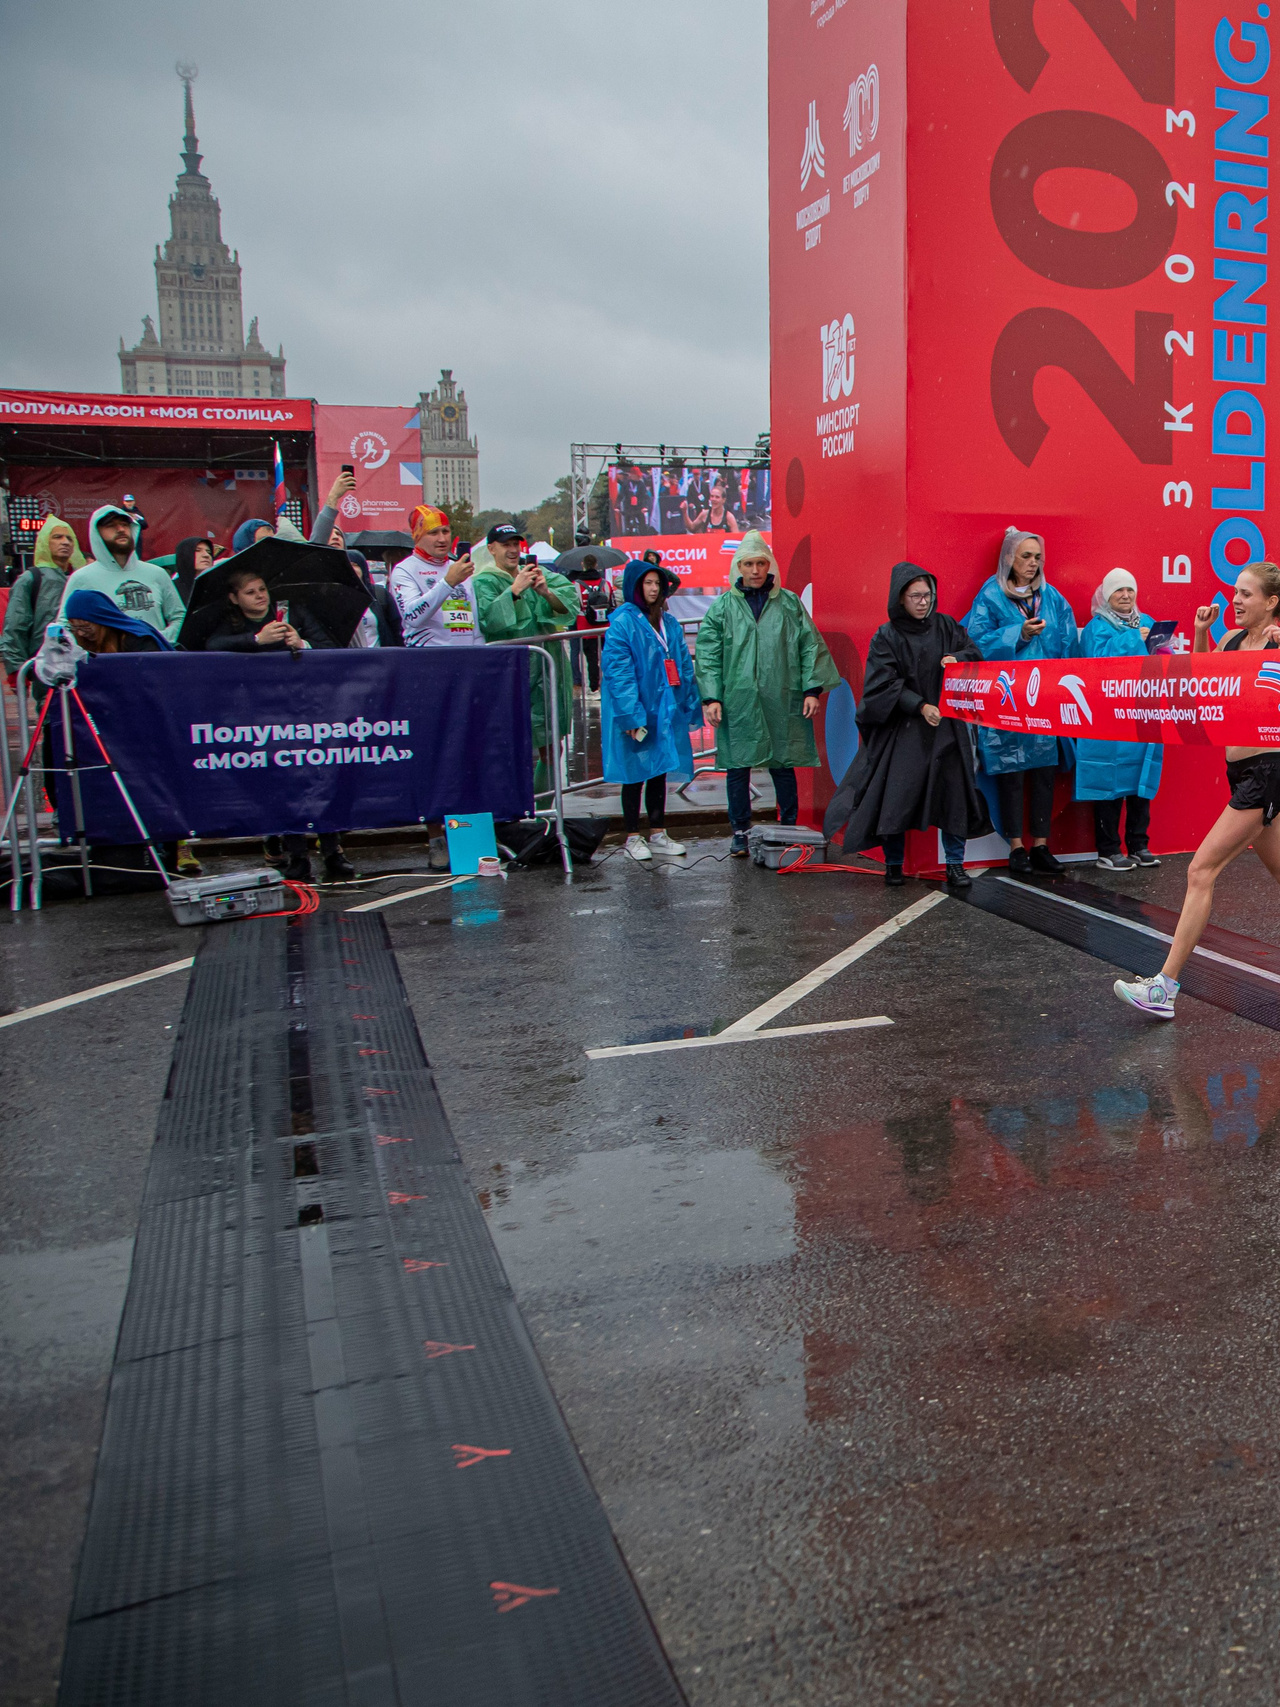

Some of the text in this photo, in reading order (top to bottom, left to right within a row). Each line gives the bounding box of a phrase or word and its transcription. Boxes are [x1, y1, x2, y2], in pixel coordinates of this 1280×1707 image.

[0, 401, 294, 423] ПОЛУМАРАФОН «МОЯ СТОЛИЦА»
[816, 403, 860, 437] МИНСПОРТ
[822, 430, 854, 459] РОССИИ
[658, 549, 707, 561] ОССИИ
[449, 612, 469, 621] 3411
[1101, 676, 1242, 698] ЧЕМПИОНАТ РОССИИ
[1114, 705, 1225, 724] по полумарафону 2023
[191, 716, 410, 747] Полумарафон
[193, 745, 414, 770] «МОЯ СТОЛИЦА»
